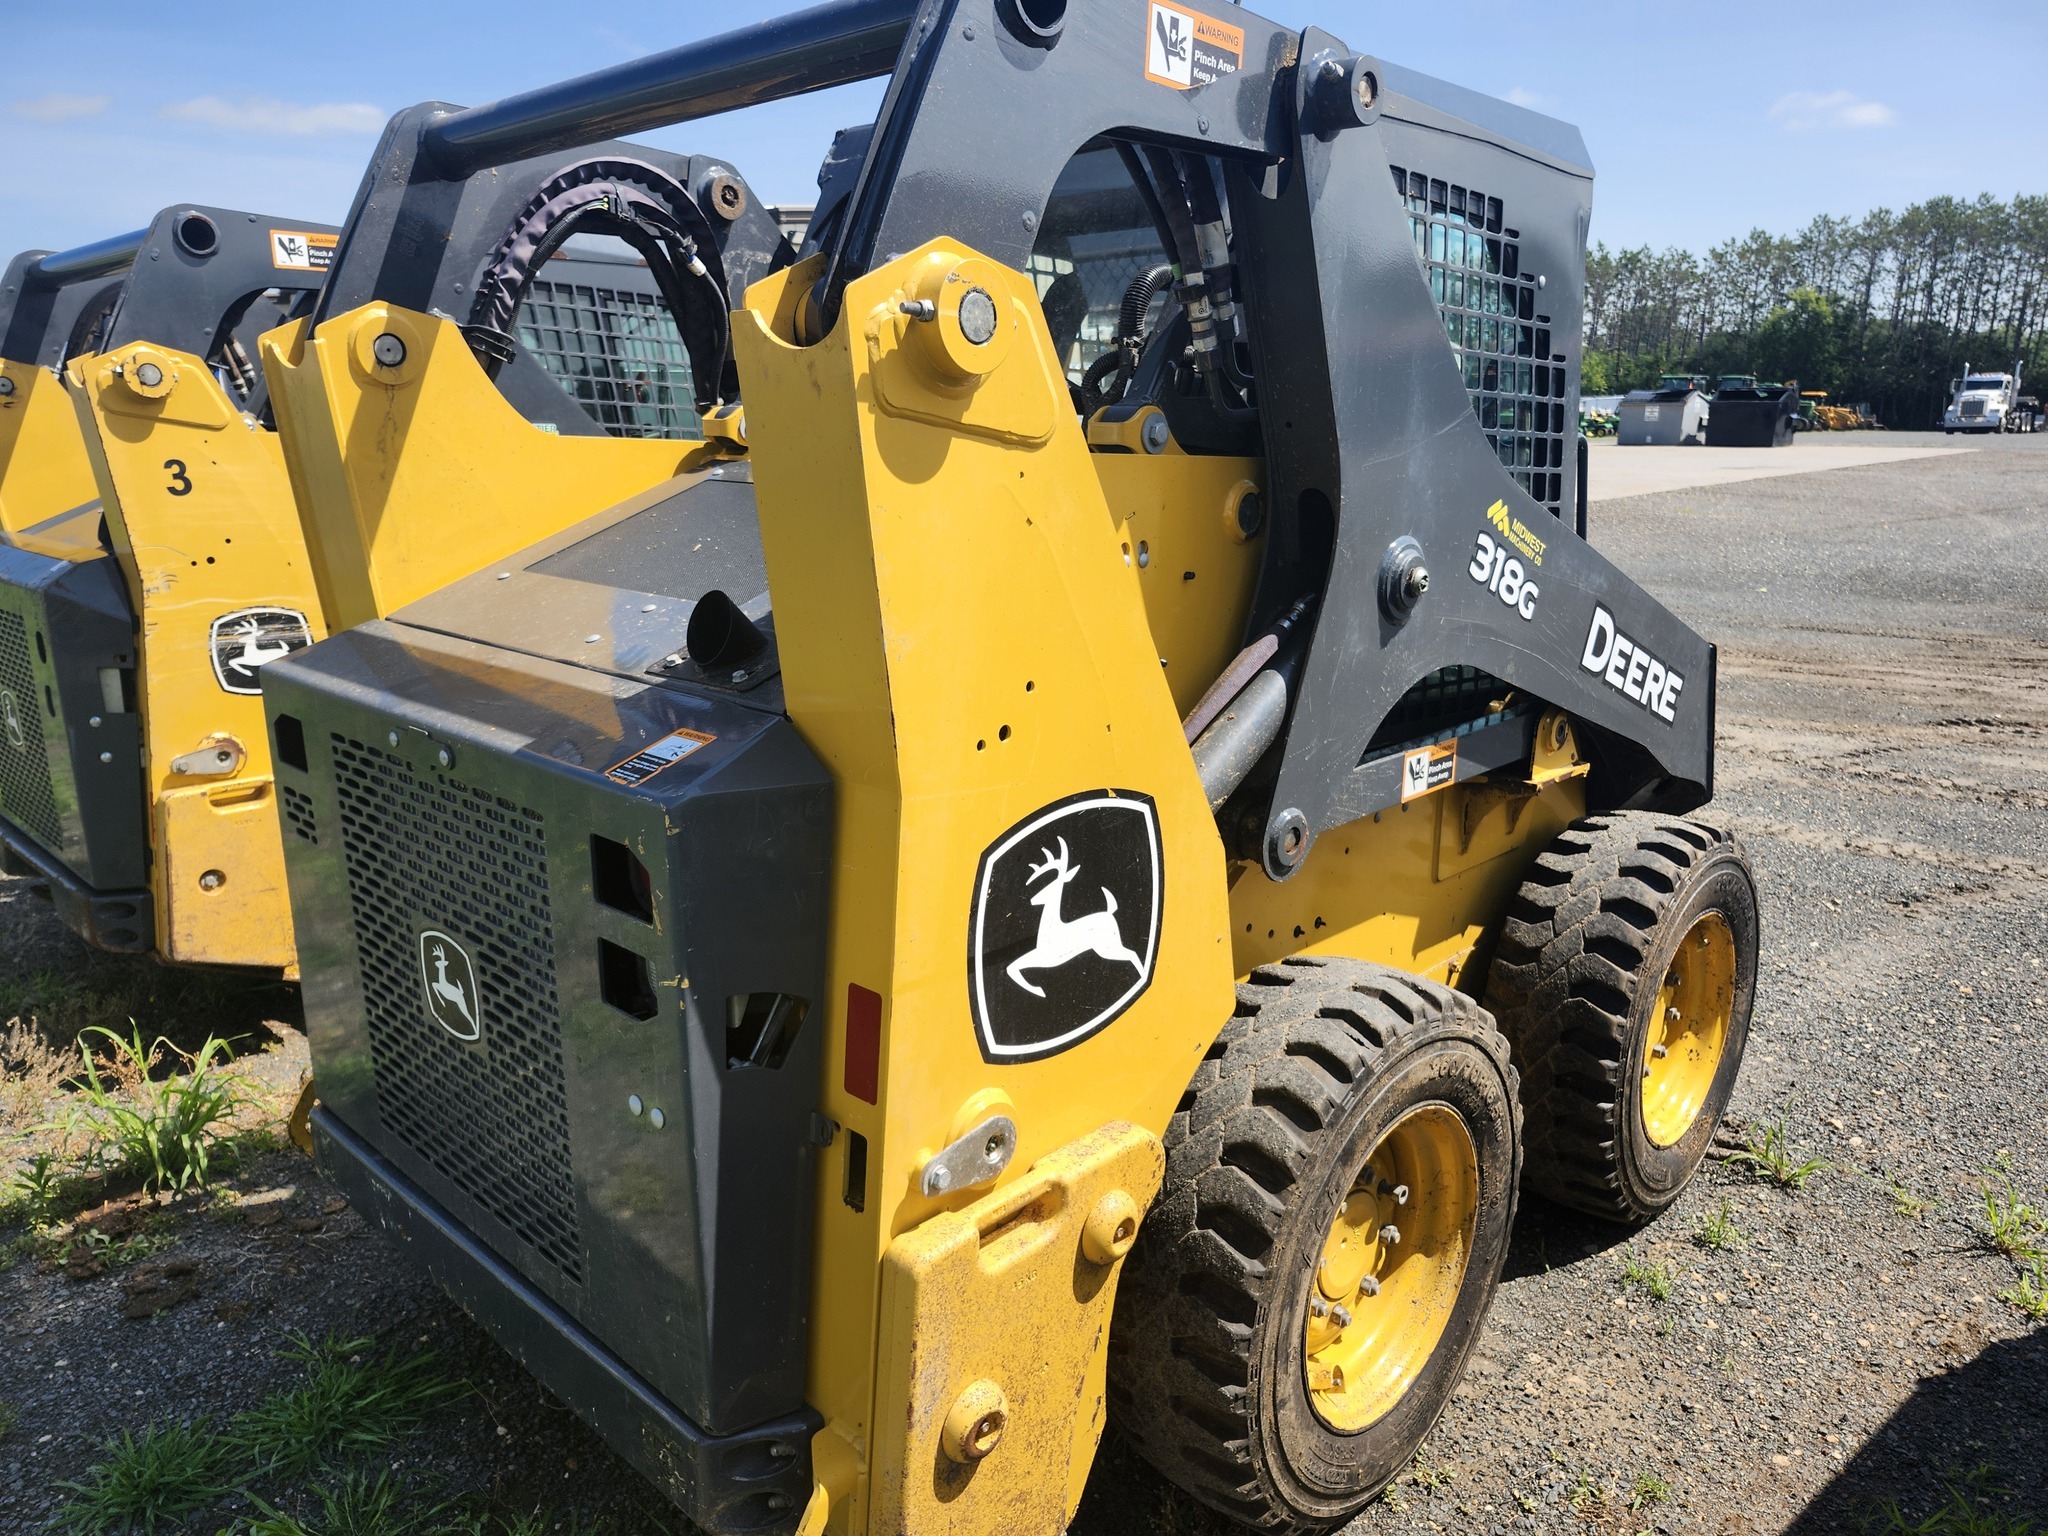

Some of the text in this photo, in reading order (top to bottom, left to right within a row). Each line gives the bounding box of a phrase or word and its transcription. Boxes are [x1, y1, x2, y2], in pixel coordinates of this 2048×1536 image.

[1204, 25, 1239, 47] WARNING
[1193, 67, 1211, 85] Keep
[1194, 49, 1217, 69] Pinch
[163, 459, 193, 497] 3
[1511, 518, 1547, 556] MIDWEST
[1468, 532, 1540, 621] 318G
[1581, 606, 1684, 722] DEERE
